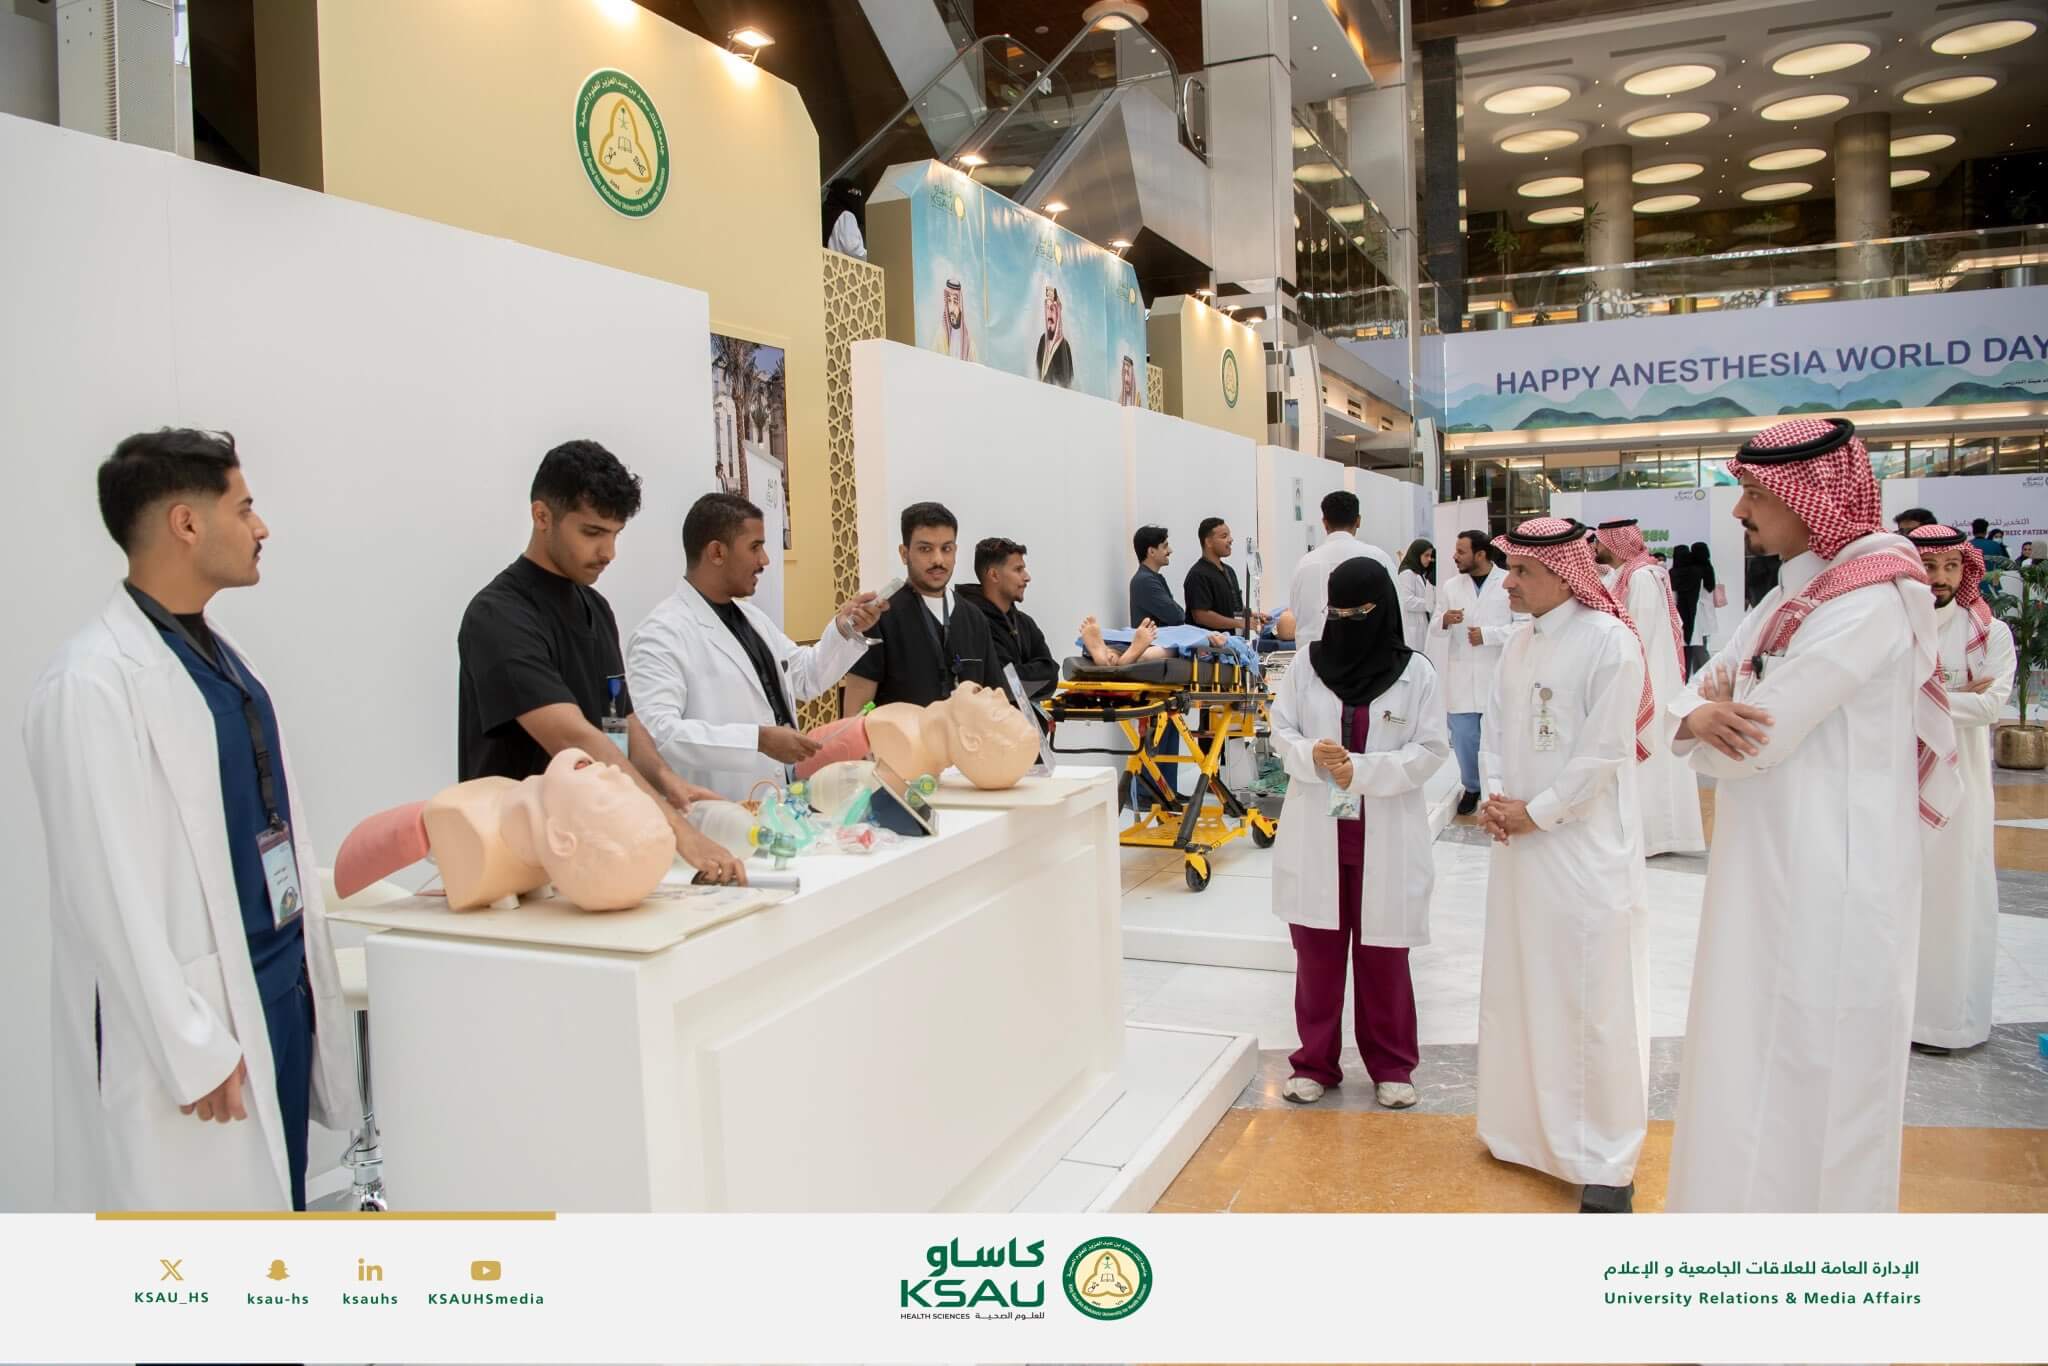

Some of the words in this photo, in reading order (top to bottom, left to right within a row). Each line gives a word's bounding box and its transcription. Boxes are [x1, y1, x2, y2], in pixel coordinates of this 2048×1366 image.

[1496, 365, 1600, 395] HAPPY
[1609, 351, 1826, 388] ANESTHESIA
[1836, 340, 1971, 373] WORLD
[1984, 334, 2048, 363] DAY
